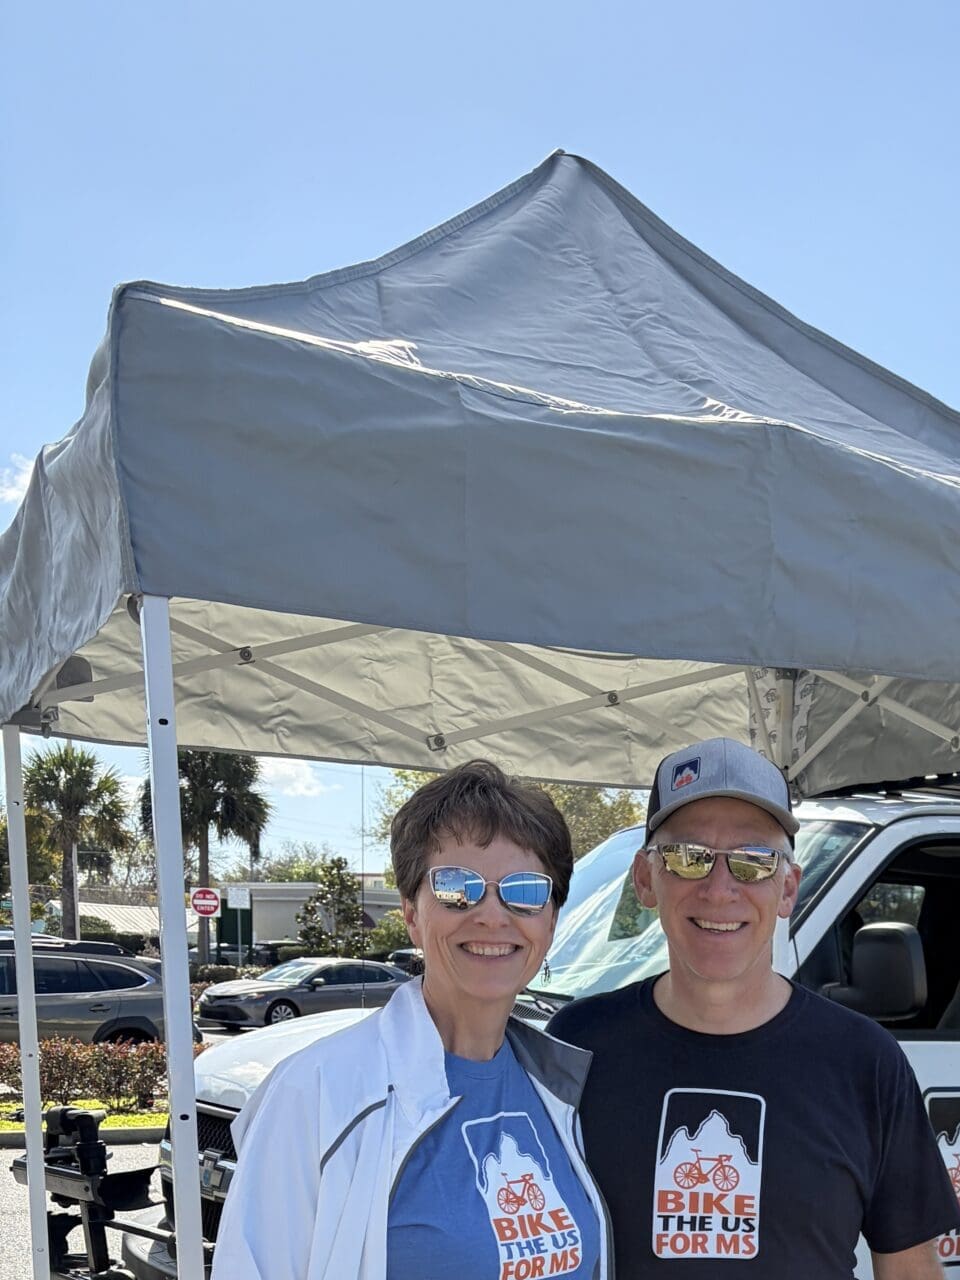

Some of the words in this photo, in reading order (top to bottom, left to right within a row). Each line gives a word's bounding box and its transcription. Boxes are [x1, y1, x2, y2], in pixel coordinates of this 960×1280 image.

[656, 1190, 757, 1217] BIKE
[492, 1207, 575, 1242] BIKE
[657, 1215, 713, 1233] THE
[721, 1216, 756, 1233] US
[501, 1238, 547, 1260] THE
[552, 1230, 579, 1251] US
[656, 1233, 708, 1256] FOR
[716, 1233, 757, 1256] MS
[550, 1247, 580, 1272] MS
